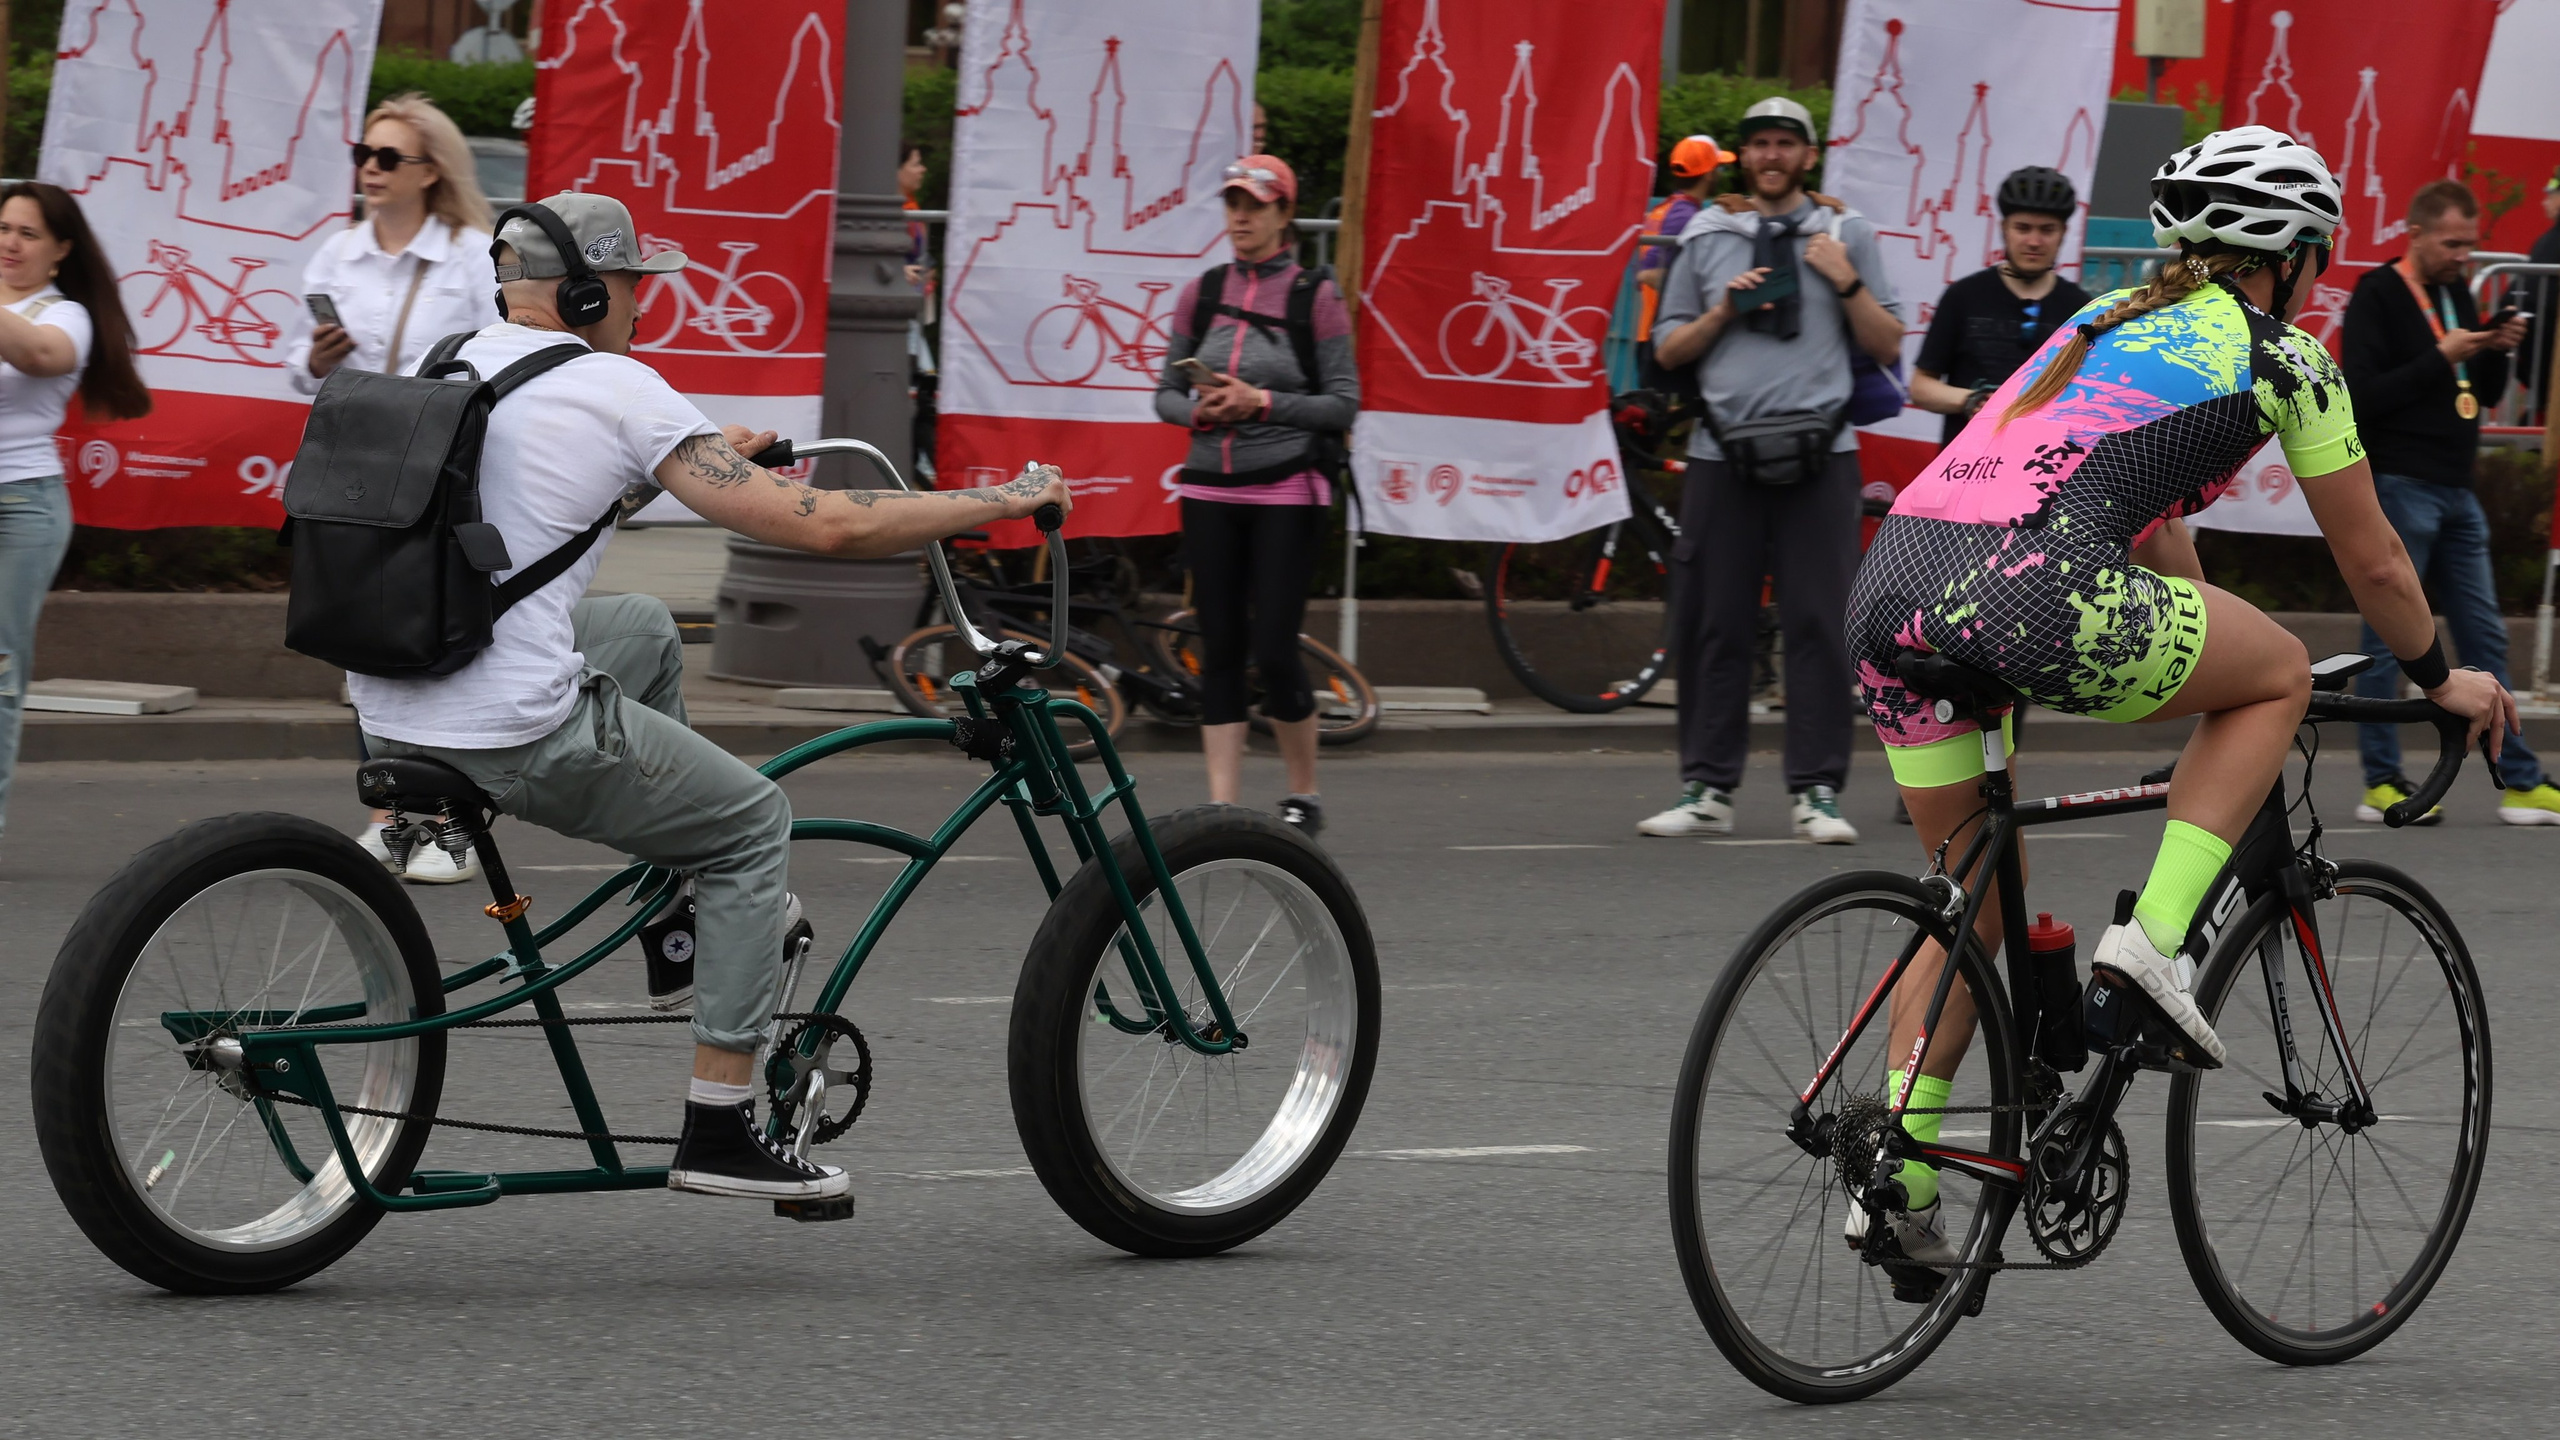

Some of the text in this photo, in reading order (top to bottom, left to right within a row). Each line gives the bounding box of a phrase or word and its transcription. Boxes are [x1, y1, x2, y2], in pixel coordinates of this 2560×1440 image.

[1939, 456, 2004, 482] kafitt
[2142, 585, 2199, 701] kafitt
[2275, 981, 2296, 1063] FOCUS
[1894, 1036, 1926, 1108] FOCUS
